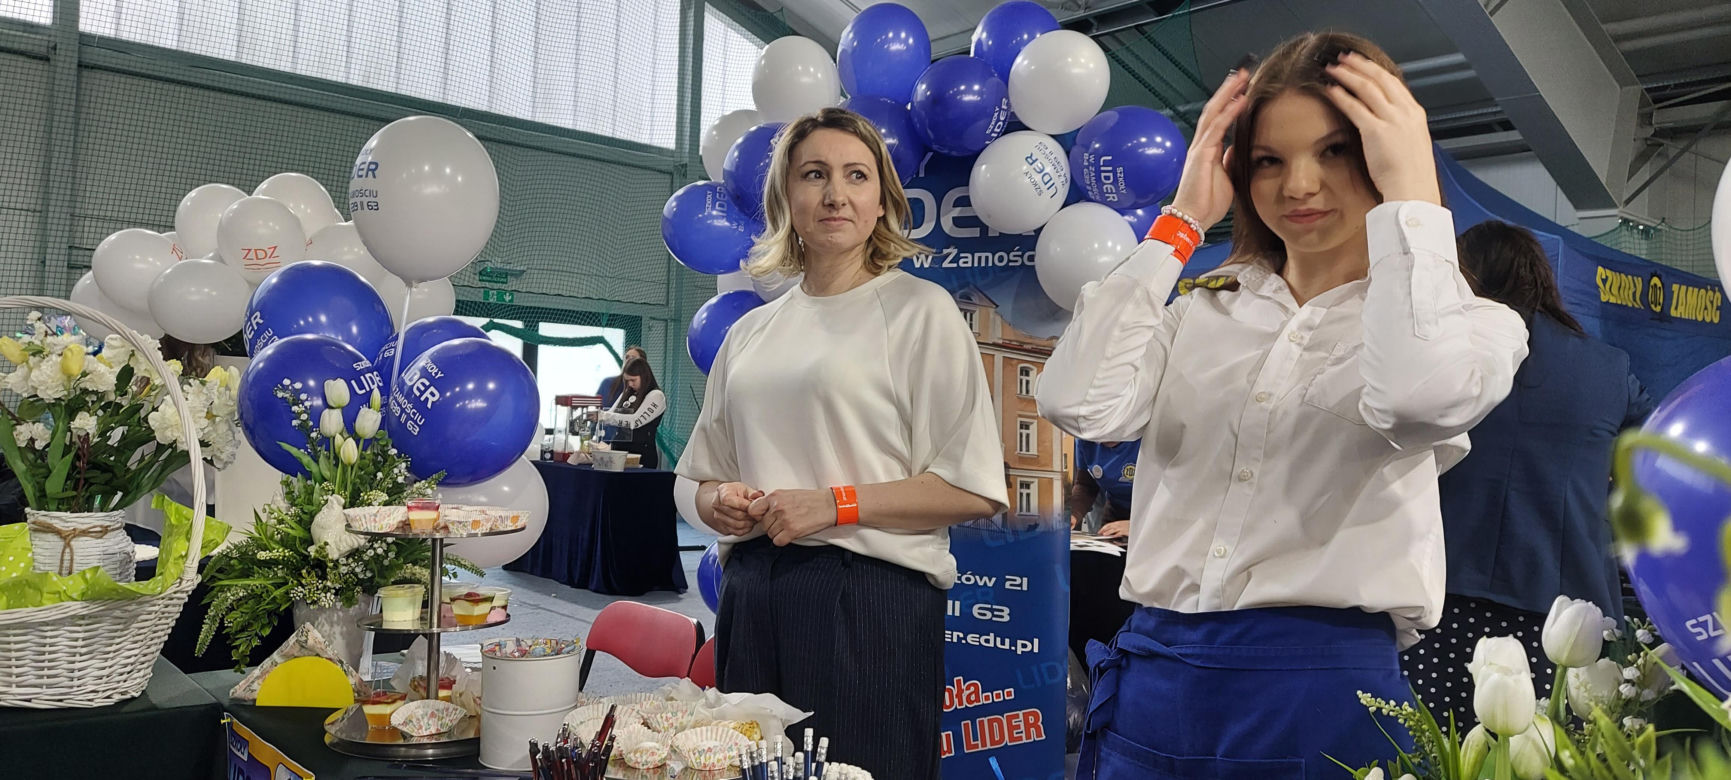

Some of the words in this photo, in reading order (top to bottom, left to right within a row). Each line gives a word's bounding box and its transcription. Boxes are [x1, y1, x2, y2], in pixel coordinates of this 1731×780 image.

[984, 97, 1008, 144] LIDER
[1024, 151, 1058, 199] LIDER
[1100, 156, 1118, 202] LIDER
[366, 201, 380, 211] 63
[241, 245, 280, 261] ZDZ
[912, 253, 932, 268] w
[1596, 266, 1644, 310] SZKOŁY
[1670, 284, 1721, 324] ZAMOŚĆ
[407, 420, 420, 436] 63
[1005, 575, 1028, 591] 21
[972, 603, 1010, 622] 63
[961, 709, 1046, 753] LIDER
